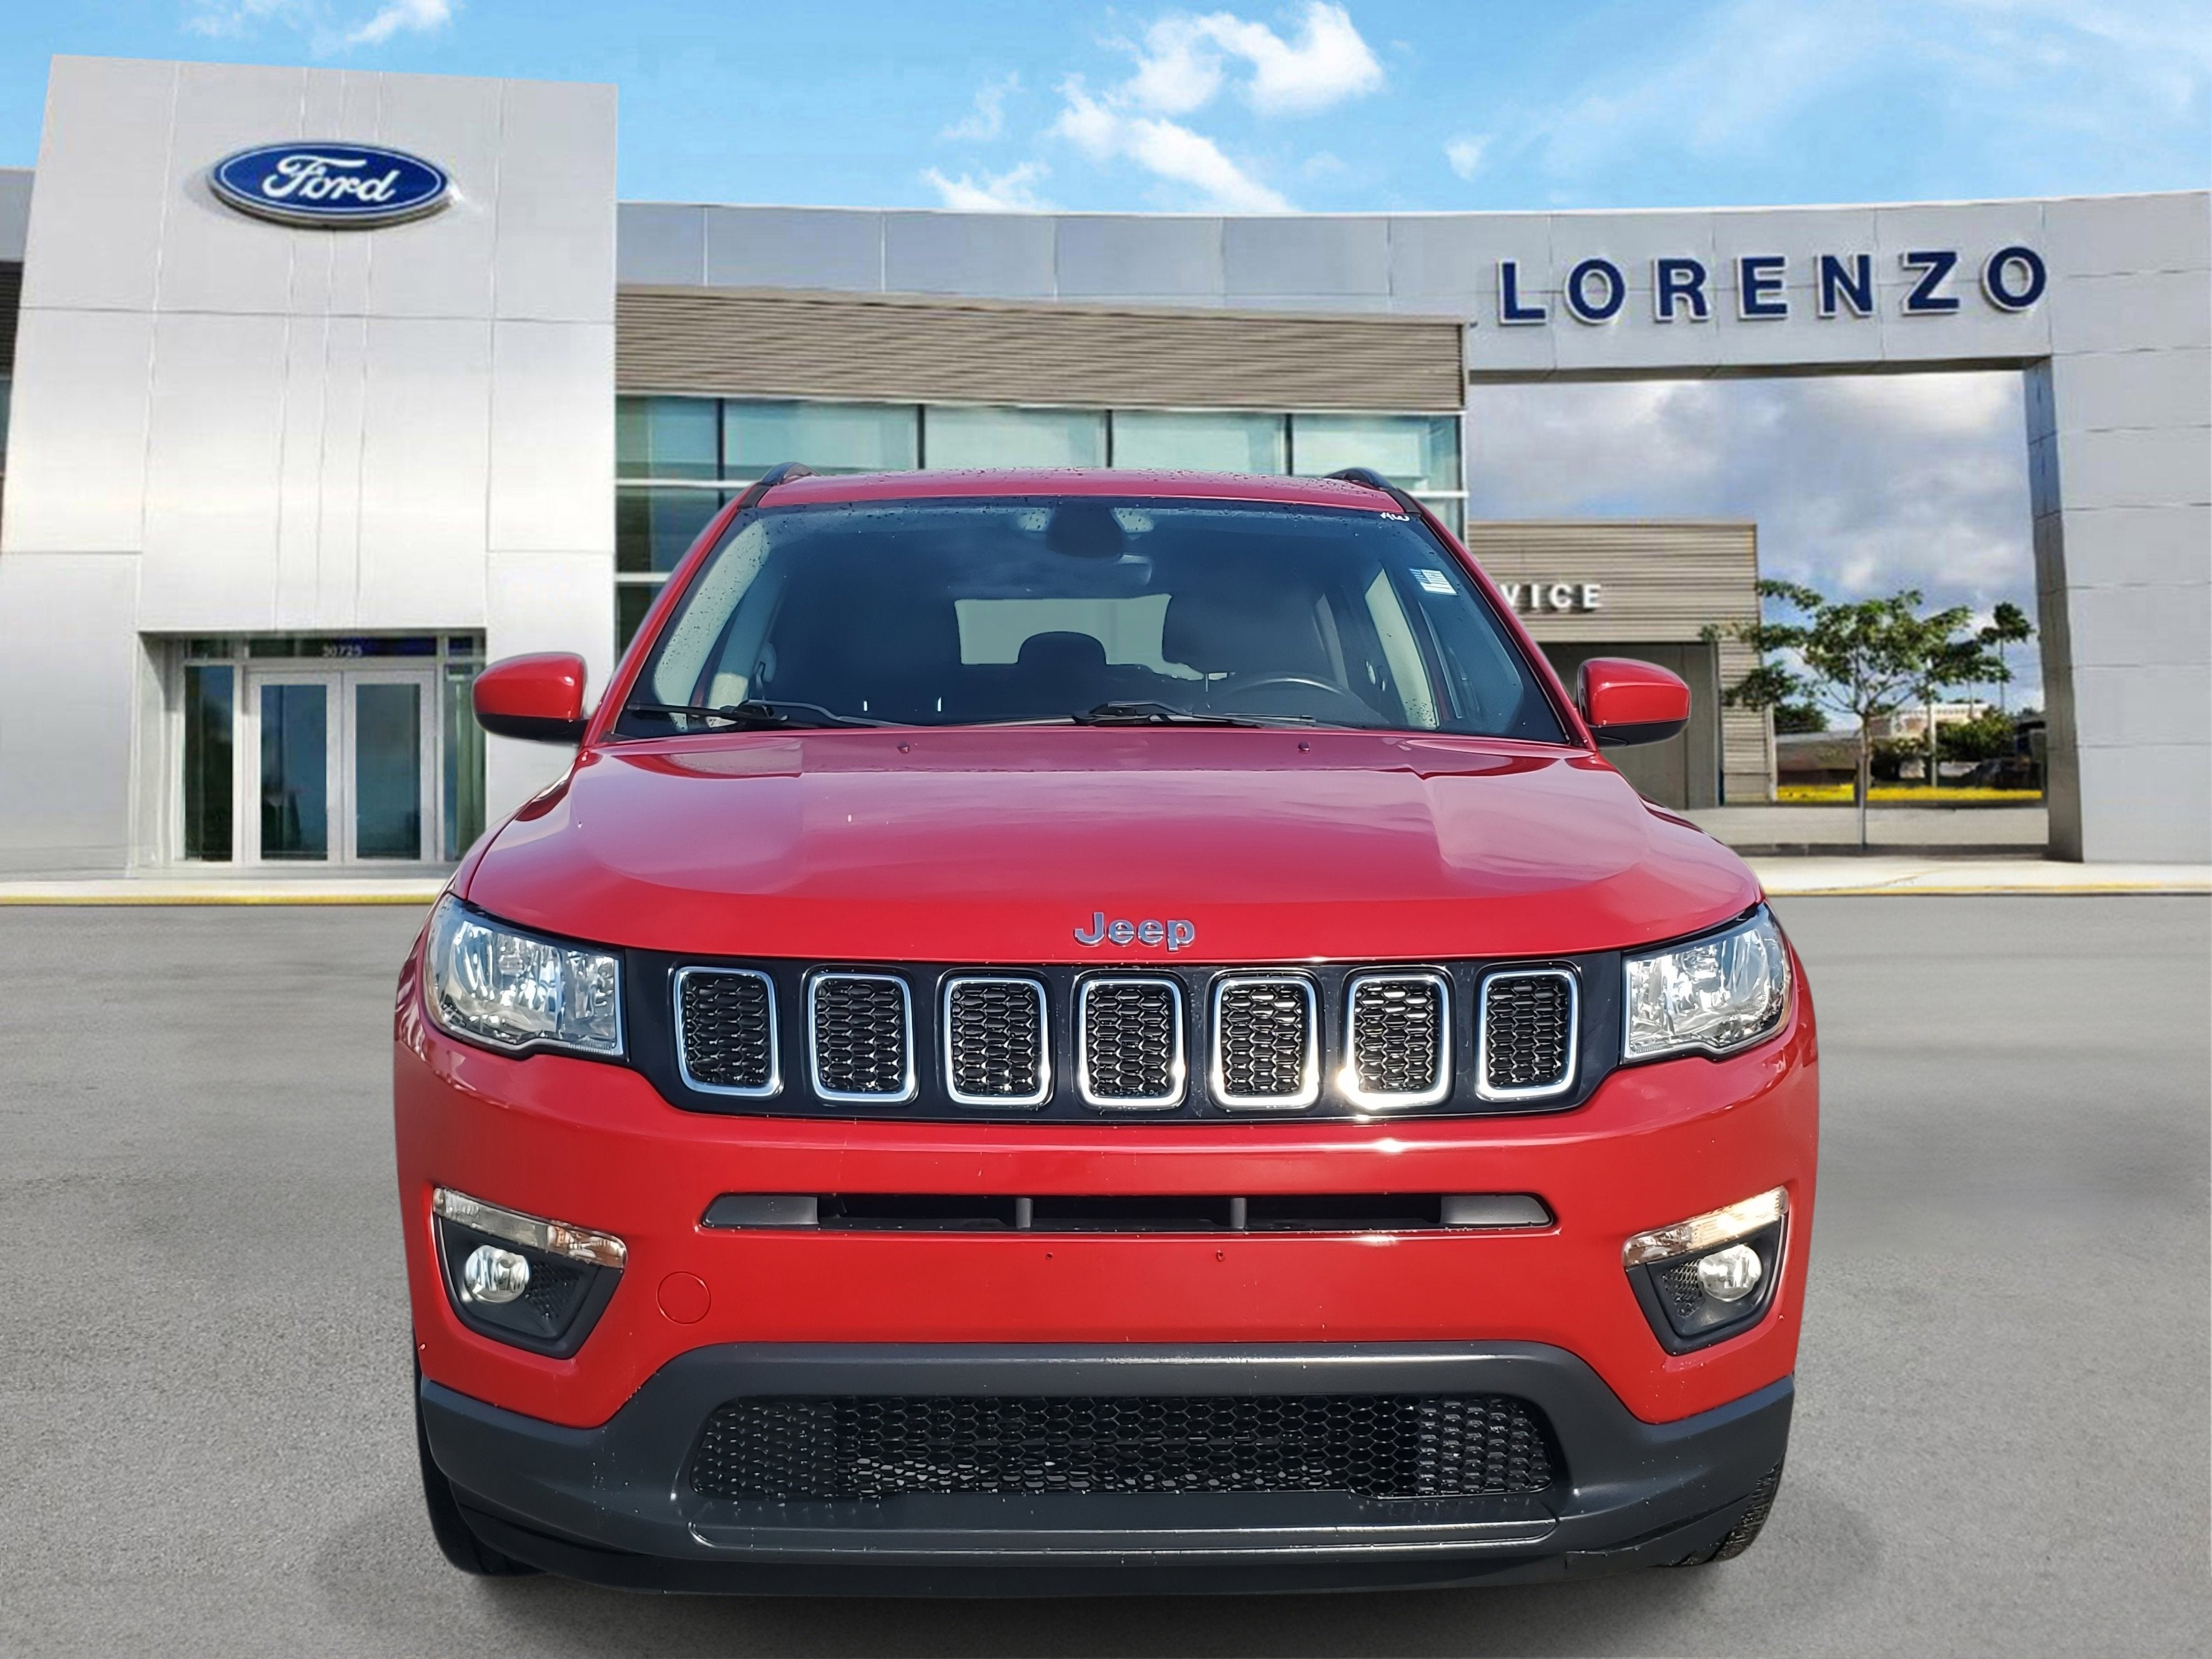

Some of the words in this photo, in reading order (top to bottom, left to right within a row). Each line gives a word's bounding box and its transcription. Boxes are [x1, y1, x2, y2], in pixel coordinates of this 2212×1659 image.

[262, 154, 400, 202] Ford
[1499, 246, 2047, 325] LORENZO
[1500, 583, 1603, 609] VICE
[1073, 912, 1195, 953] Jeep
